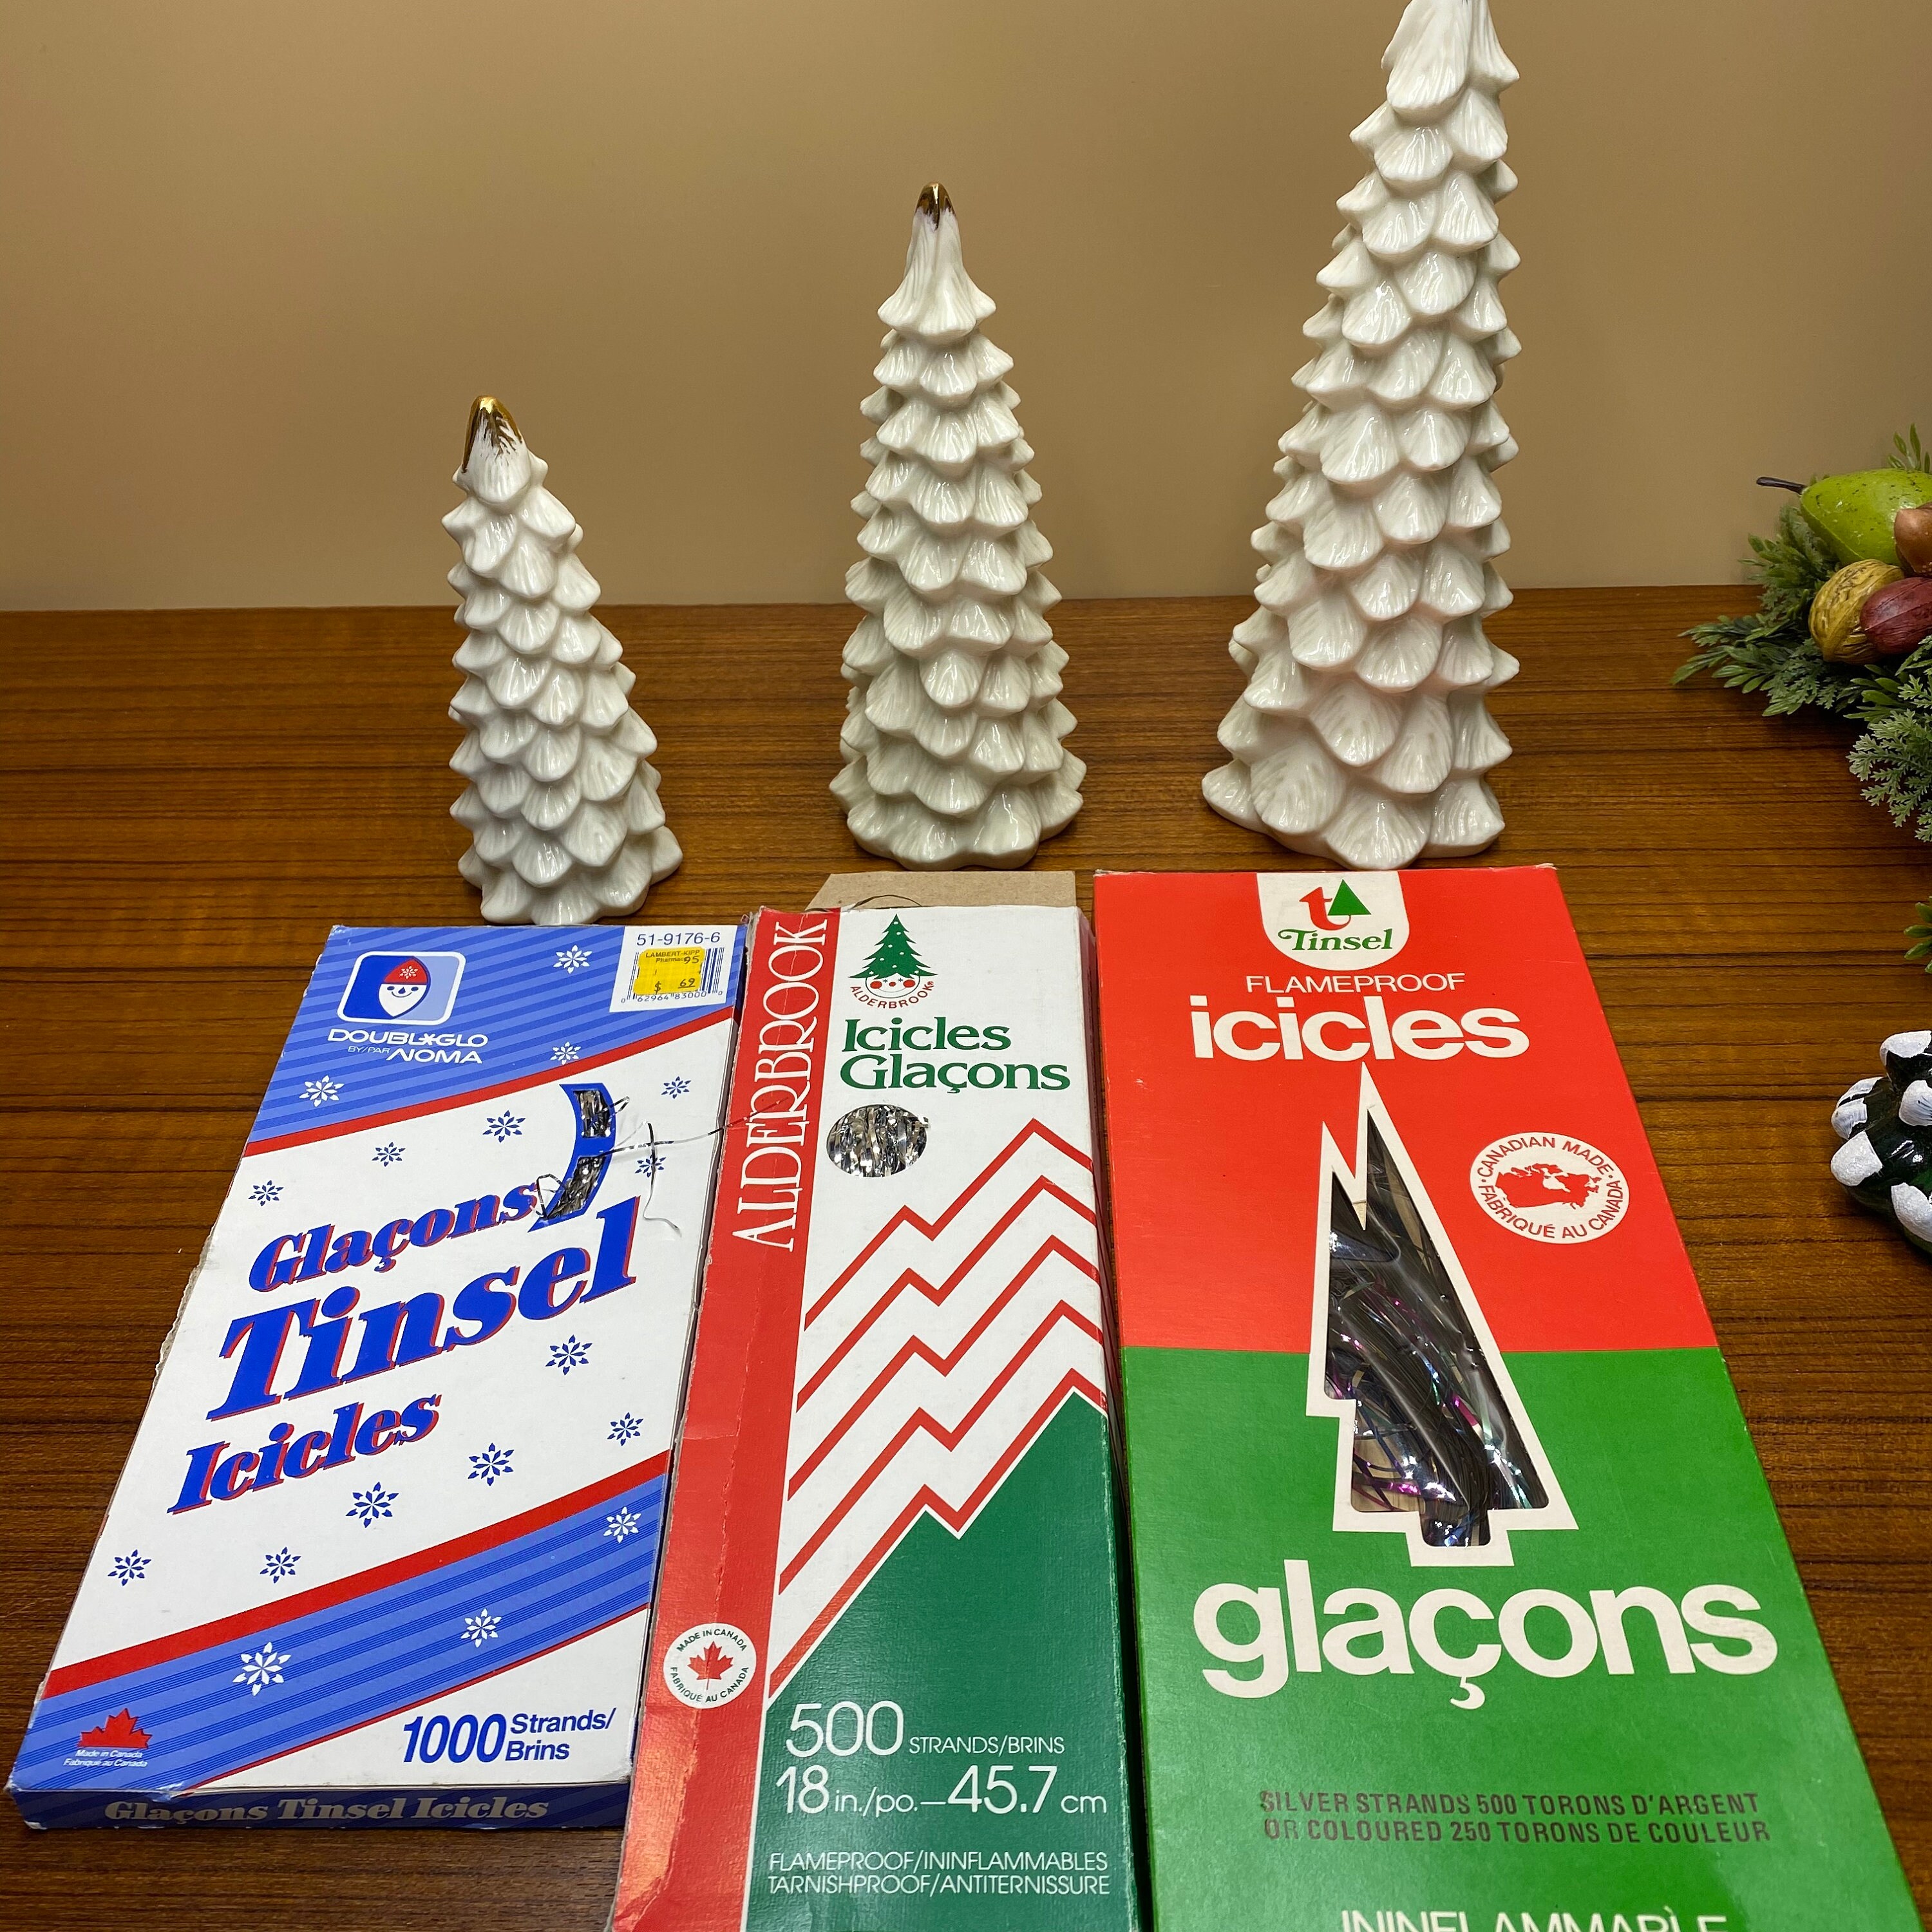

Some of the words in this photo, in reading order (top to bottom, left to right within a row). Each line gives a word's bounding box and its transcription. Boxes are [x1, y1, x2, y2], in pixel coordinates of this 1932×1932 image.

[636, 932, 721, 946] 51-9176-6
[1278, 928, 1393, 951] Tinsel
[684, 955, 700, 964] 95
[654, 981, 661, 995] $
[676, 991, 707, 999] 83000
[1246, 972, 1466, 994] FLAMEPROOF
[841, 1016, 1012, 1052] Icicles
[1189, 995, 1530, 1062] icicles
[348, 1046, 390, 1054] BY/PAR
[386, 1048, 482, 1064] NOMA
[732, 918, 829, 1253] ALDERBROOK
[840, 1054, 1071, 1094] Glaçons
[1477, 1137, 1556, 1178] CANADIAN
[1562, 1141, 1615, 1175] MADE
[1478, 1185, 1556, 1238] FABRIQUÉ
[1562, 1224, 1587, 1238] AU
[1588, 1180, 1624, 1231] CANADA
[249, 1182, 538, 1293] Glaçons
[205, 1196, 641, 1422] Tinsel
[167, 1394, 442, 1515] Icicles
[676, 1632, 701, 1652] MADE
[714, 1629, 748, 1651] CANADA
[1193, 1559, 1779, 1710] glaçons
[670, 1667, 703, 1702] FABRIQUÉ
[705, 1694, 717, 1703] AU
[720, 1667, 749, 1698] CANADA
[403, 1714, 507, 1763] 1000
[510, 1707, 617, 1734] Strands/
[786, 1700, 904, 1757] 500
[909, 1735, 1065, 1757] STRANDS/BRINS
[114, 1759, 148, 1767] Canada
[505, 1739, 570, 1761] Brins
[775, 1765, 829, 1814] 18
[1061, 1795, 1107, 1814] cm
[1260, 1790, 1350, 1813] SILVER
[1356, 1792, 1471, 1814] STRANDS
[1477, 1794, 1517, 1815] 500
[1522, 1794, 1626, 1815] TORONS
[1631, 1793, 1759, 1816] D'ARGENT
[104, 1801, 269, 1824] Glaçons
[277, 1798, 407, 1819] Tinsel
[411, 1797, 549, 1819] Icicles
[1265, 1818, 1300, 1840] OR
[1307, 1819, 1442, 1841] COLOURED
[1450, 1821, 1491, 1841] 250
[1496, 1821, 1601, 1843] TORONS
[1608, 1823, 1642, 1843] DE
[1647, 1821, 1770, 1842] COULEUR
[770, 1850, 1108, 1873] FLAMEPROOF/ININFLAMMABLES
[768, 1873, 1110, 1897] TARNISHPROOF/ANTITERNISSURE
